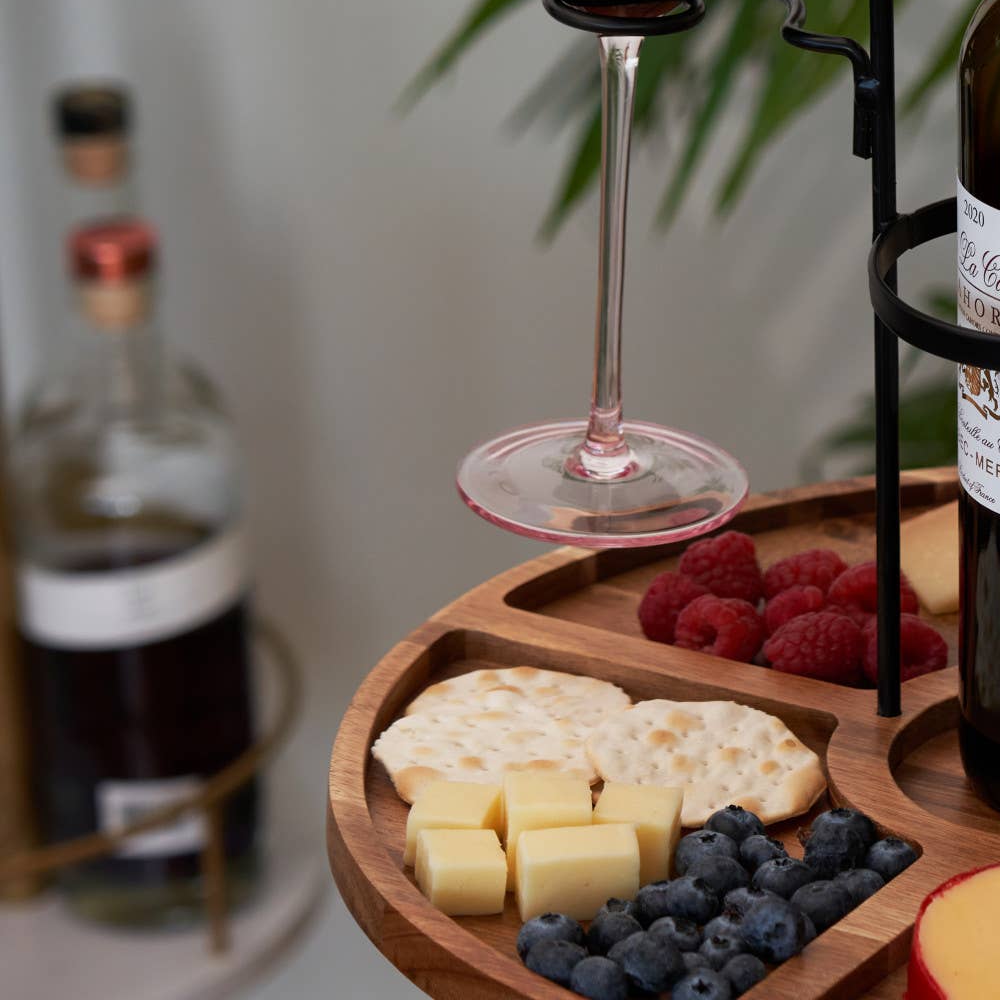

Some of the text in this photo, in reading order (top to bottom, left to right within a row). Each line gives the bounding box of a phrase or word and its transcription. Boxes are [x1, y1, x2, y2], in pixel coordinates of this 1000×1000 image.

[963, 199, 985, 228] 2020
[959, 231, 979, 278] La
[981, 438, 995, 449] au
[973, 481, 997, 504] France
